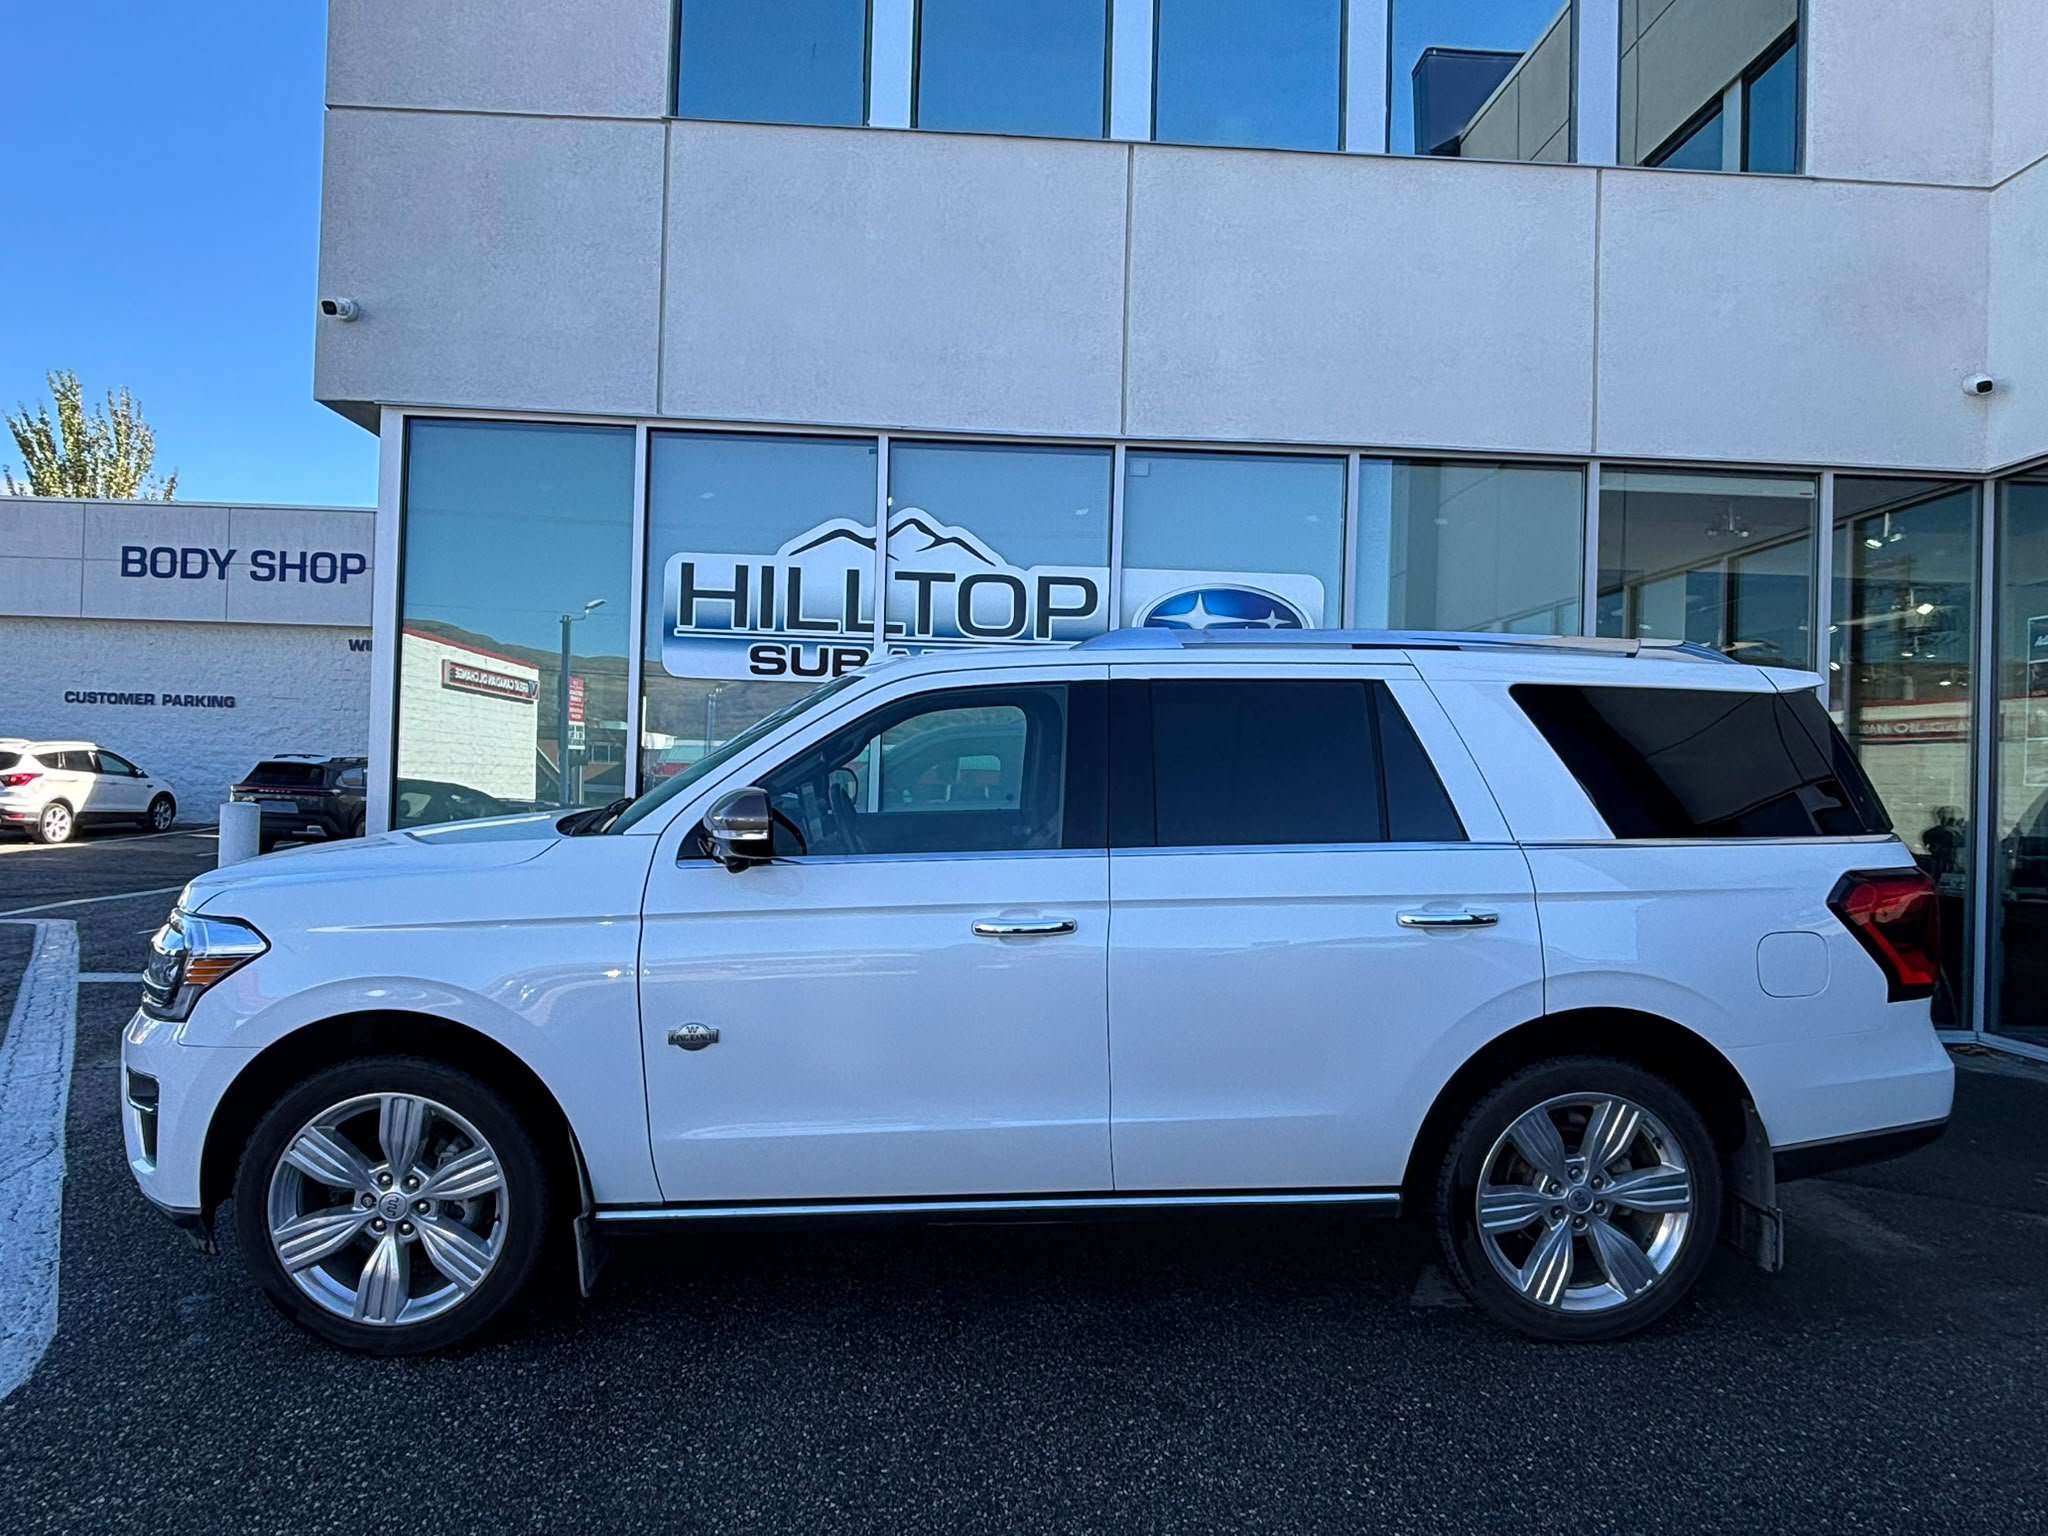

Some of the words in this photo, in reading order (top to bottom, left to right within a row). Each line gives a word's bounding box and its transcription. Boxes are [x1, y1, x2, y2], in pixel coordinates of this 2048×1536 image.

[121, 546, 236, 580] BODY
[249, 550, 366, 584] SHOP
[679, 561, 1099, 638] HILLTOP
[749, 645, 925, 677] SUB
[64, 690, 155, 706] CUSTOMER
[161, 694, 236, 709] PARKING
